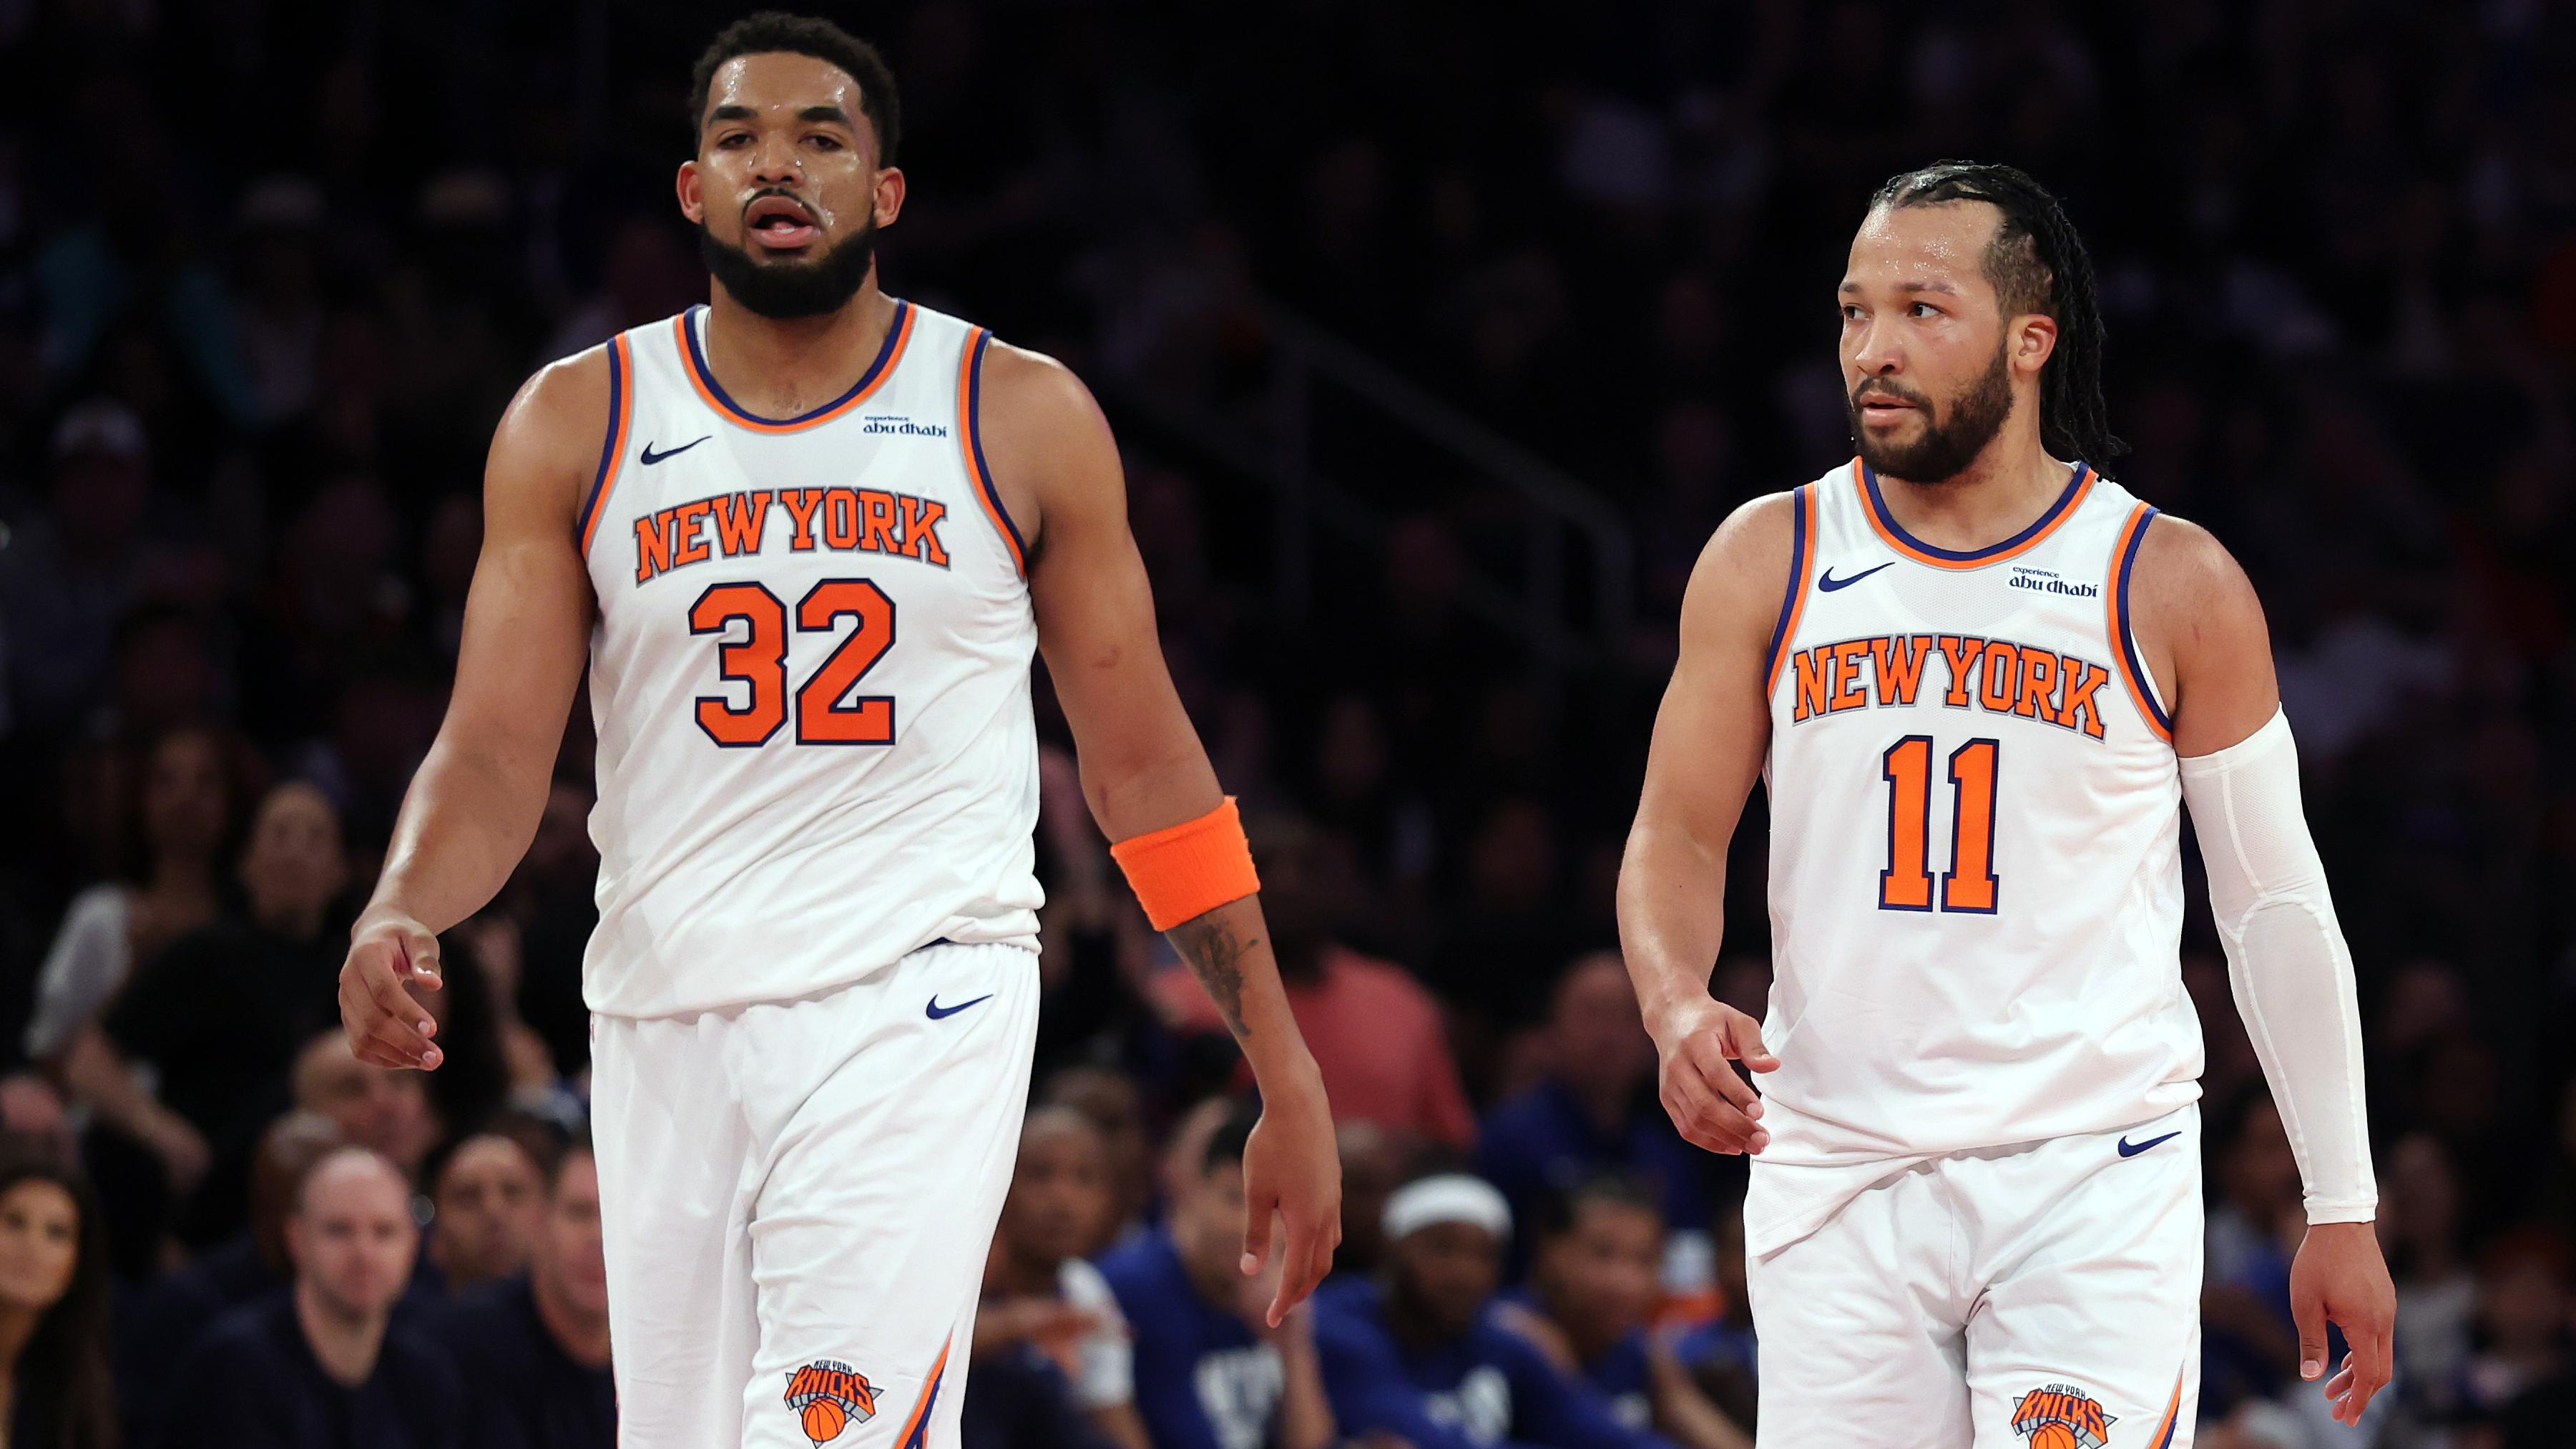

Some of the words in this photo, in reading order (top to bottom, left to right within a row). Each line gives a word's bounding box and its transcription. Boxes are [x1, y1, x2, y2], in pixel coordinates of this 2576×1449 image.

[863, 422, 896, 434] abu
[634, 489, 774, 588] NEW
[778, 487, 951, 571] YORK
[2009, 575, 2044, 591] abu
[2012, 566, 2060, 578] experience
[688, 577, 896, 748] 32
[1792, 633, 1934, 726] NEW
[1938, 633, 2112, 743] YORK
[1879, 734, 1999, 914] 11
[784, 1365, 876, 1415] KNICKS
[814, 1360, 831, 1370] NEW
[833, 1361, 853, 1374] YORK
[2045, 1383, 2065, 1392] NEW
[2065, 1385, 2086, 1400] YORK
[2011, 1388, 2107, 1443] KNICKS
